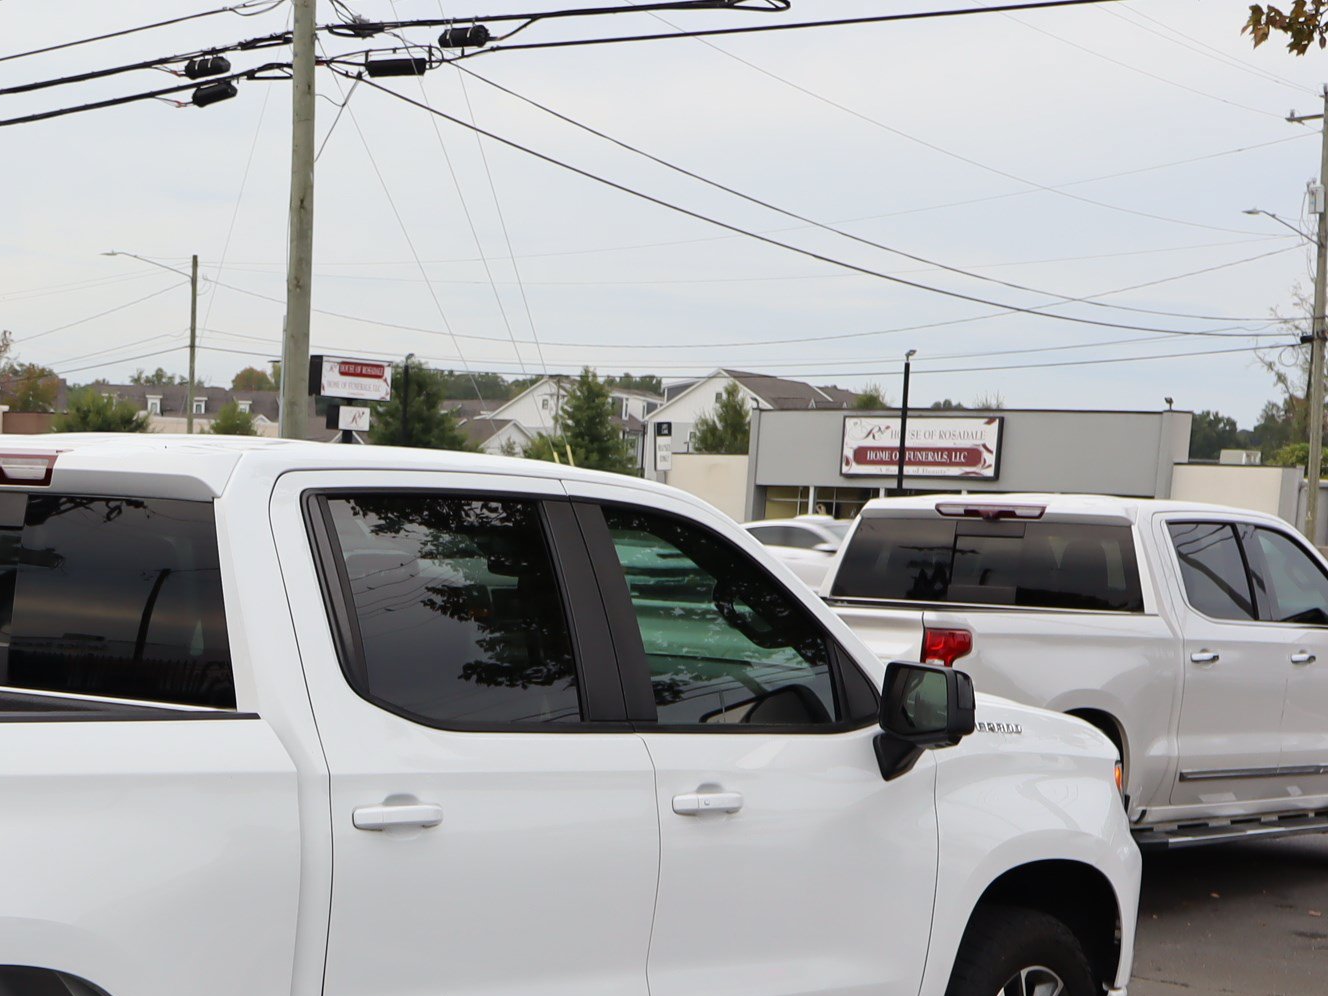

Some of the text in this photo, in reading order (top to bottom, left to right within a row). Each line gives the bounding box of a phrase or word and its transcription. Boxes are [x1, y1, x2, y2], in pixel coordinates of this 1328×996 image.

[890, 429, 986, 441] HOSE OF ROSADALE
[867, 450, 891, 461] HOME
[905, 451, 949, 463] FUNERALS,
[952, 451, 968, 462] LLC
